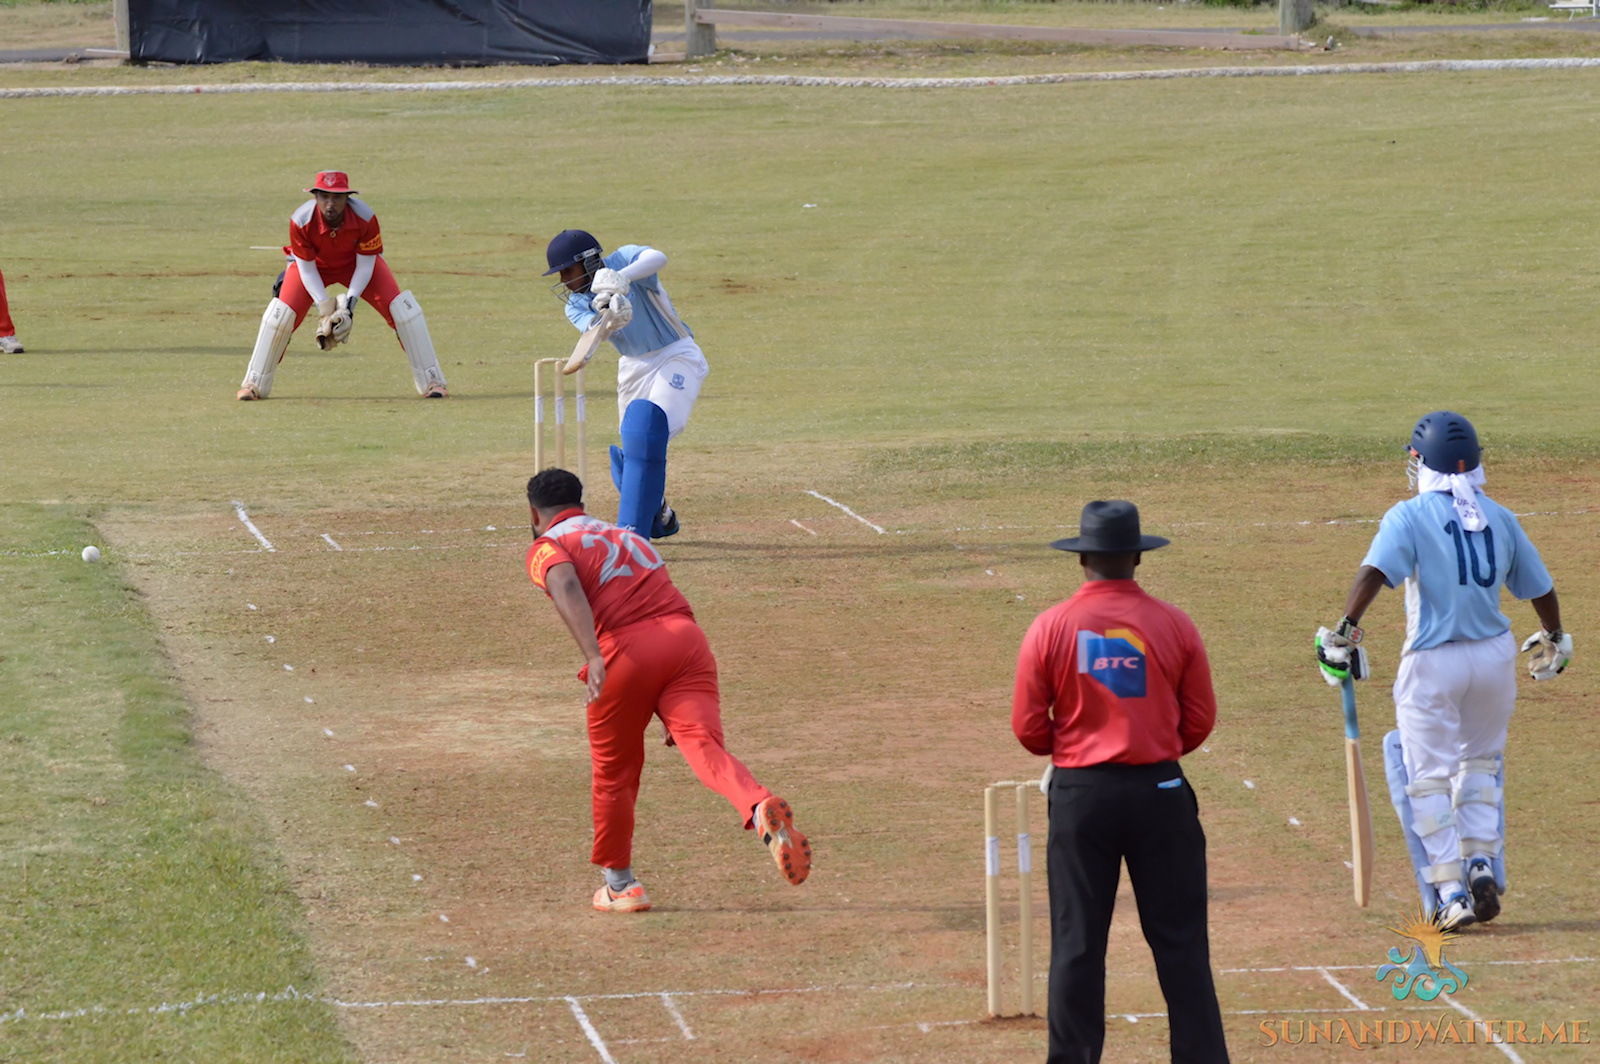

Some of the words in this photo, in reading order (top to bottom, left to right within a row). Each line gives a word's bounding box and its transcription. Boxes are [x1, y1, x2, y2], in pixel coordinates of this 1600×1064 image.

[582, 532, 664, 584] 20
[1444, 520, 1496, 588] 10
[1093, 657, 1139, 670] BTC
